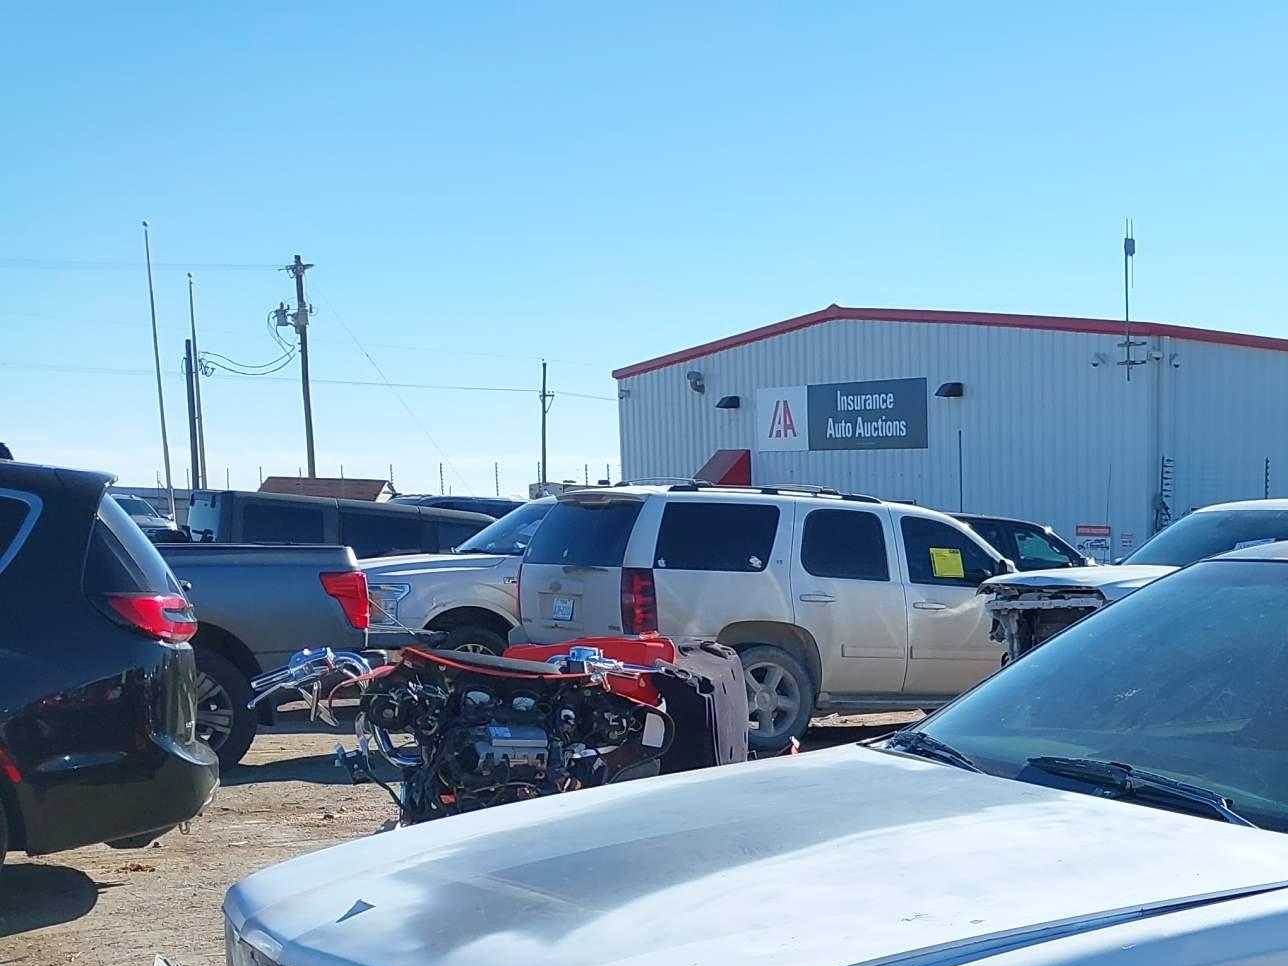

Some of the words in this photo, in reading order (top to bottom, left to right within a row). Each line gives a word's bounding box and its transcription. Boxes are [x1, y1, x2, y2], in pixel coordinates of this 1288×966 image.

[837, 390, 894, 411] Insurance
[826, 417, 851, 438] Auto
[855, 415, 907, 438] Auctions
